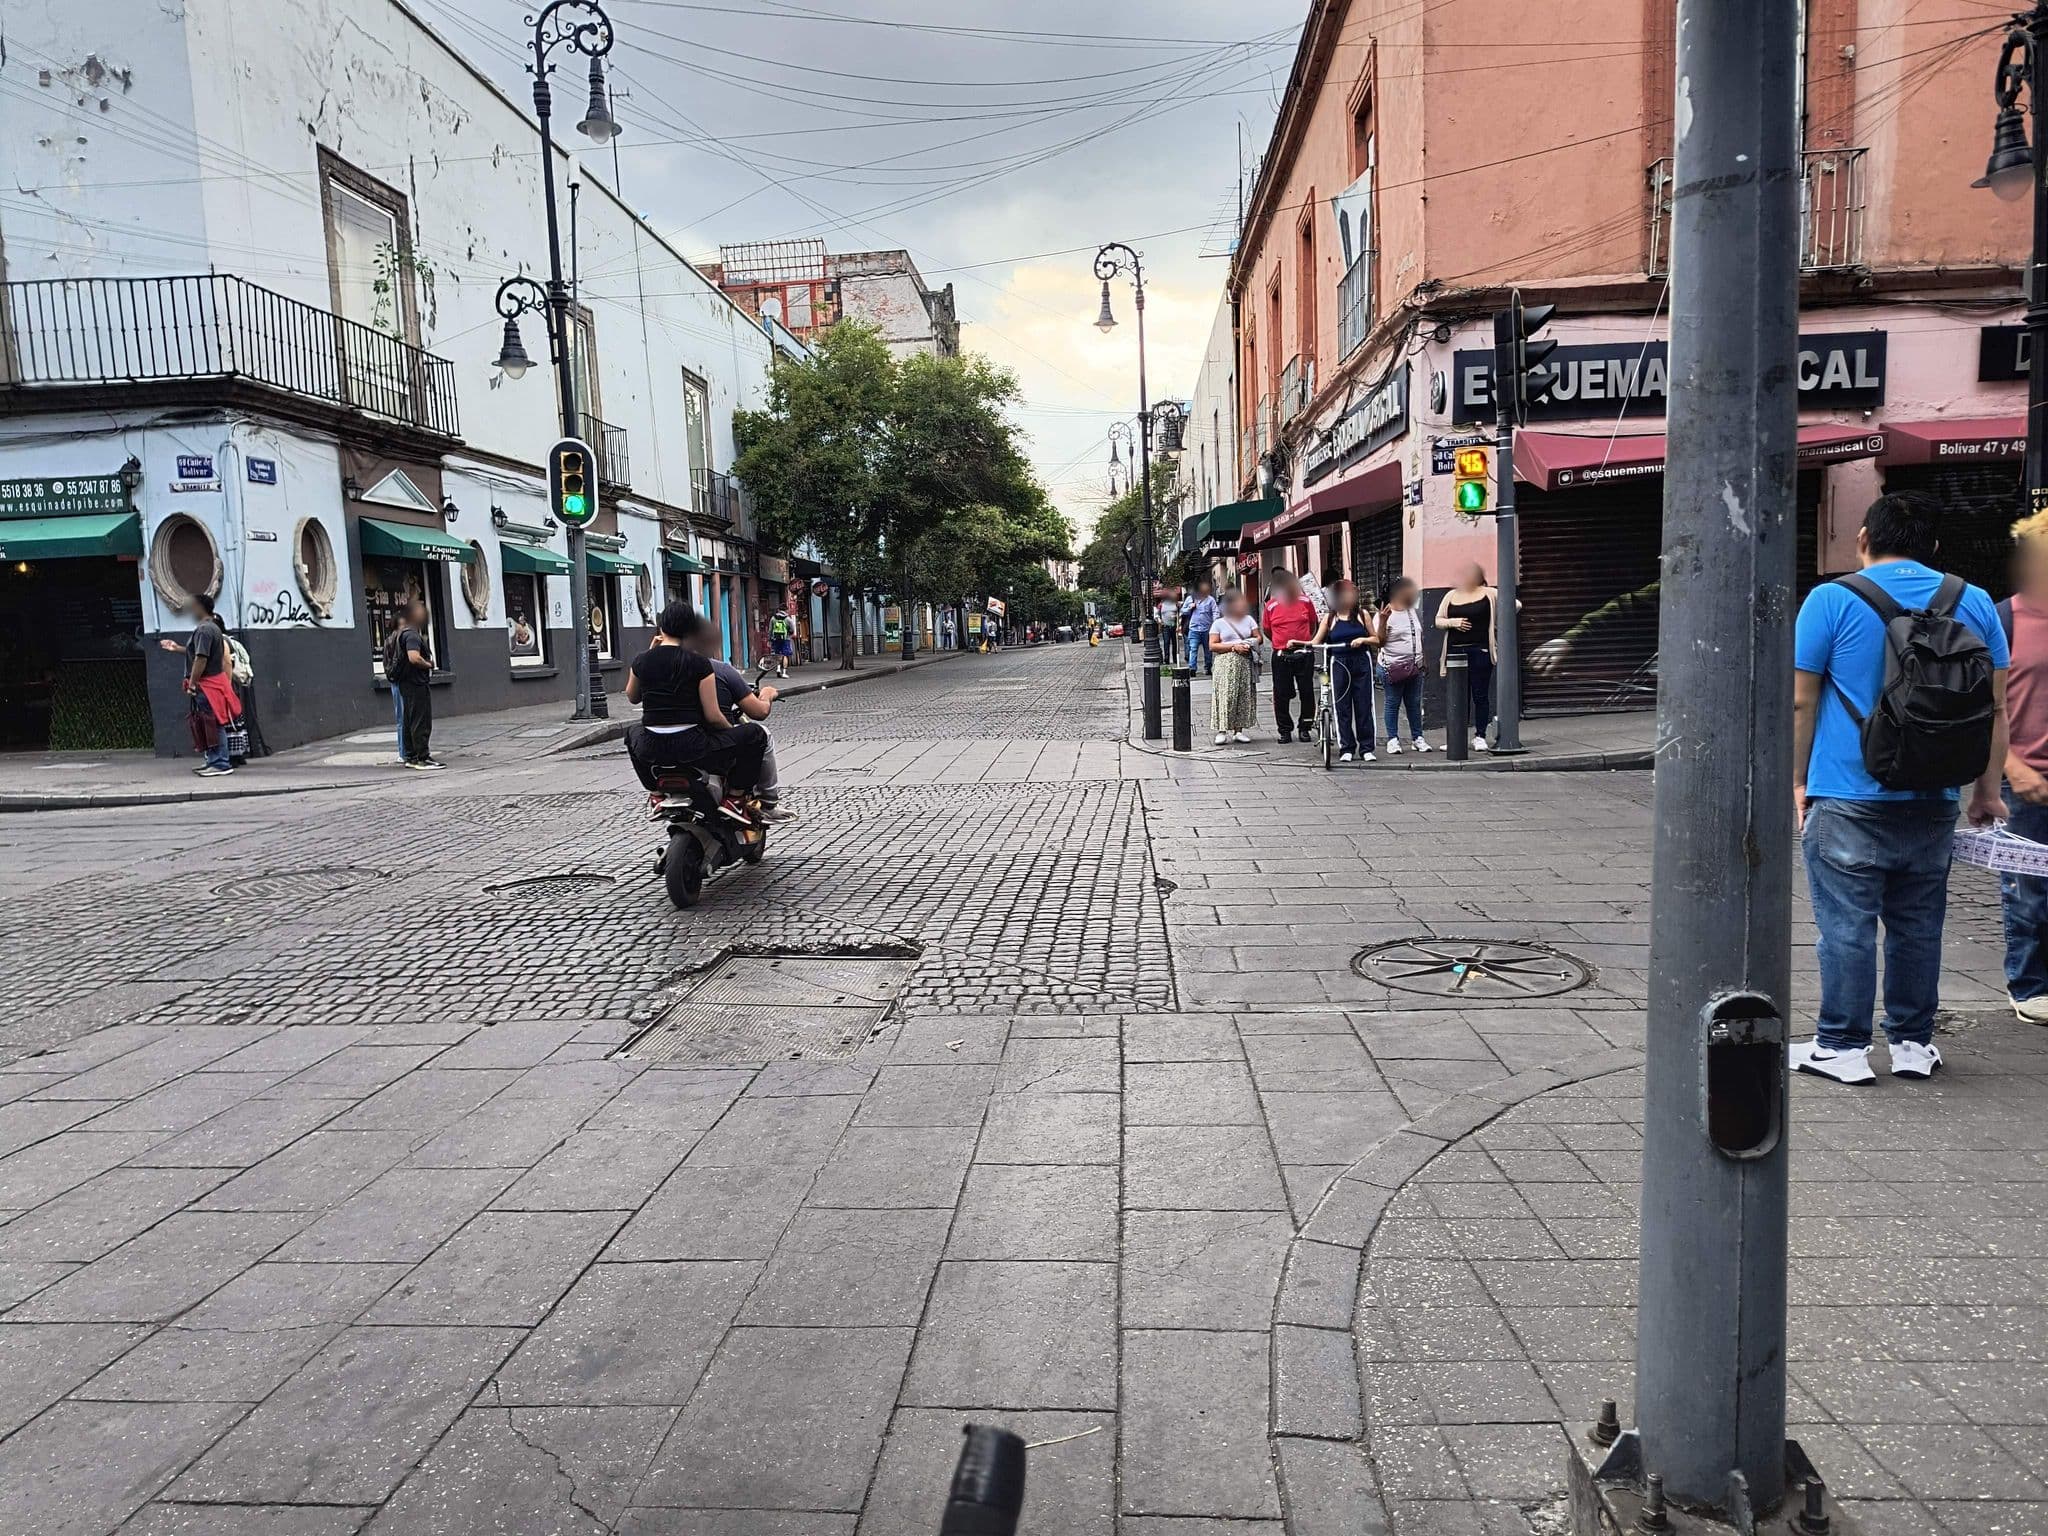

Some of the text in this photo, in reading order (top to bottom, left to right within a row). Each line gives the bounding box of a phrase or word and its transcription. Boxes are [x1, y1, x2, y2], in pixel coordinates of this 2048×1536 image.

[1464, 348, 1879, 405] EUEMA CAL
[1798, 440, 1864, 457] mamusical
[1983, 441, 1998, 453] 47
[2000, 444, 2009, 456] y
[2011, 440, 2026, 452] 49
[1582, 464, 1667, 481] @esquemamu
[1, 483, 44, 499] 5518 38 36
[67, 479, 121, 496] 55 2347 87 86
[421, 544, 460, 555] La Esquina
